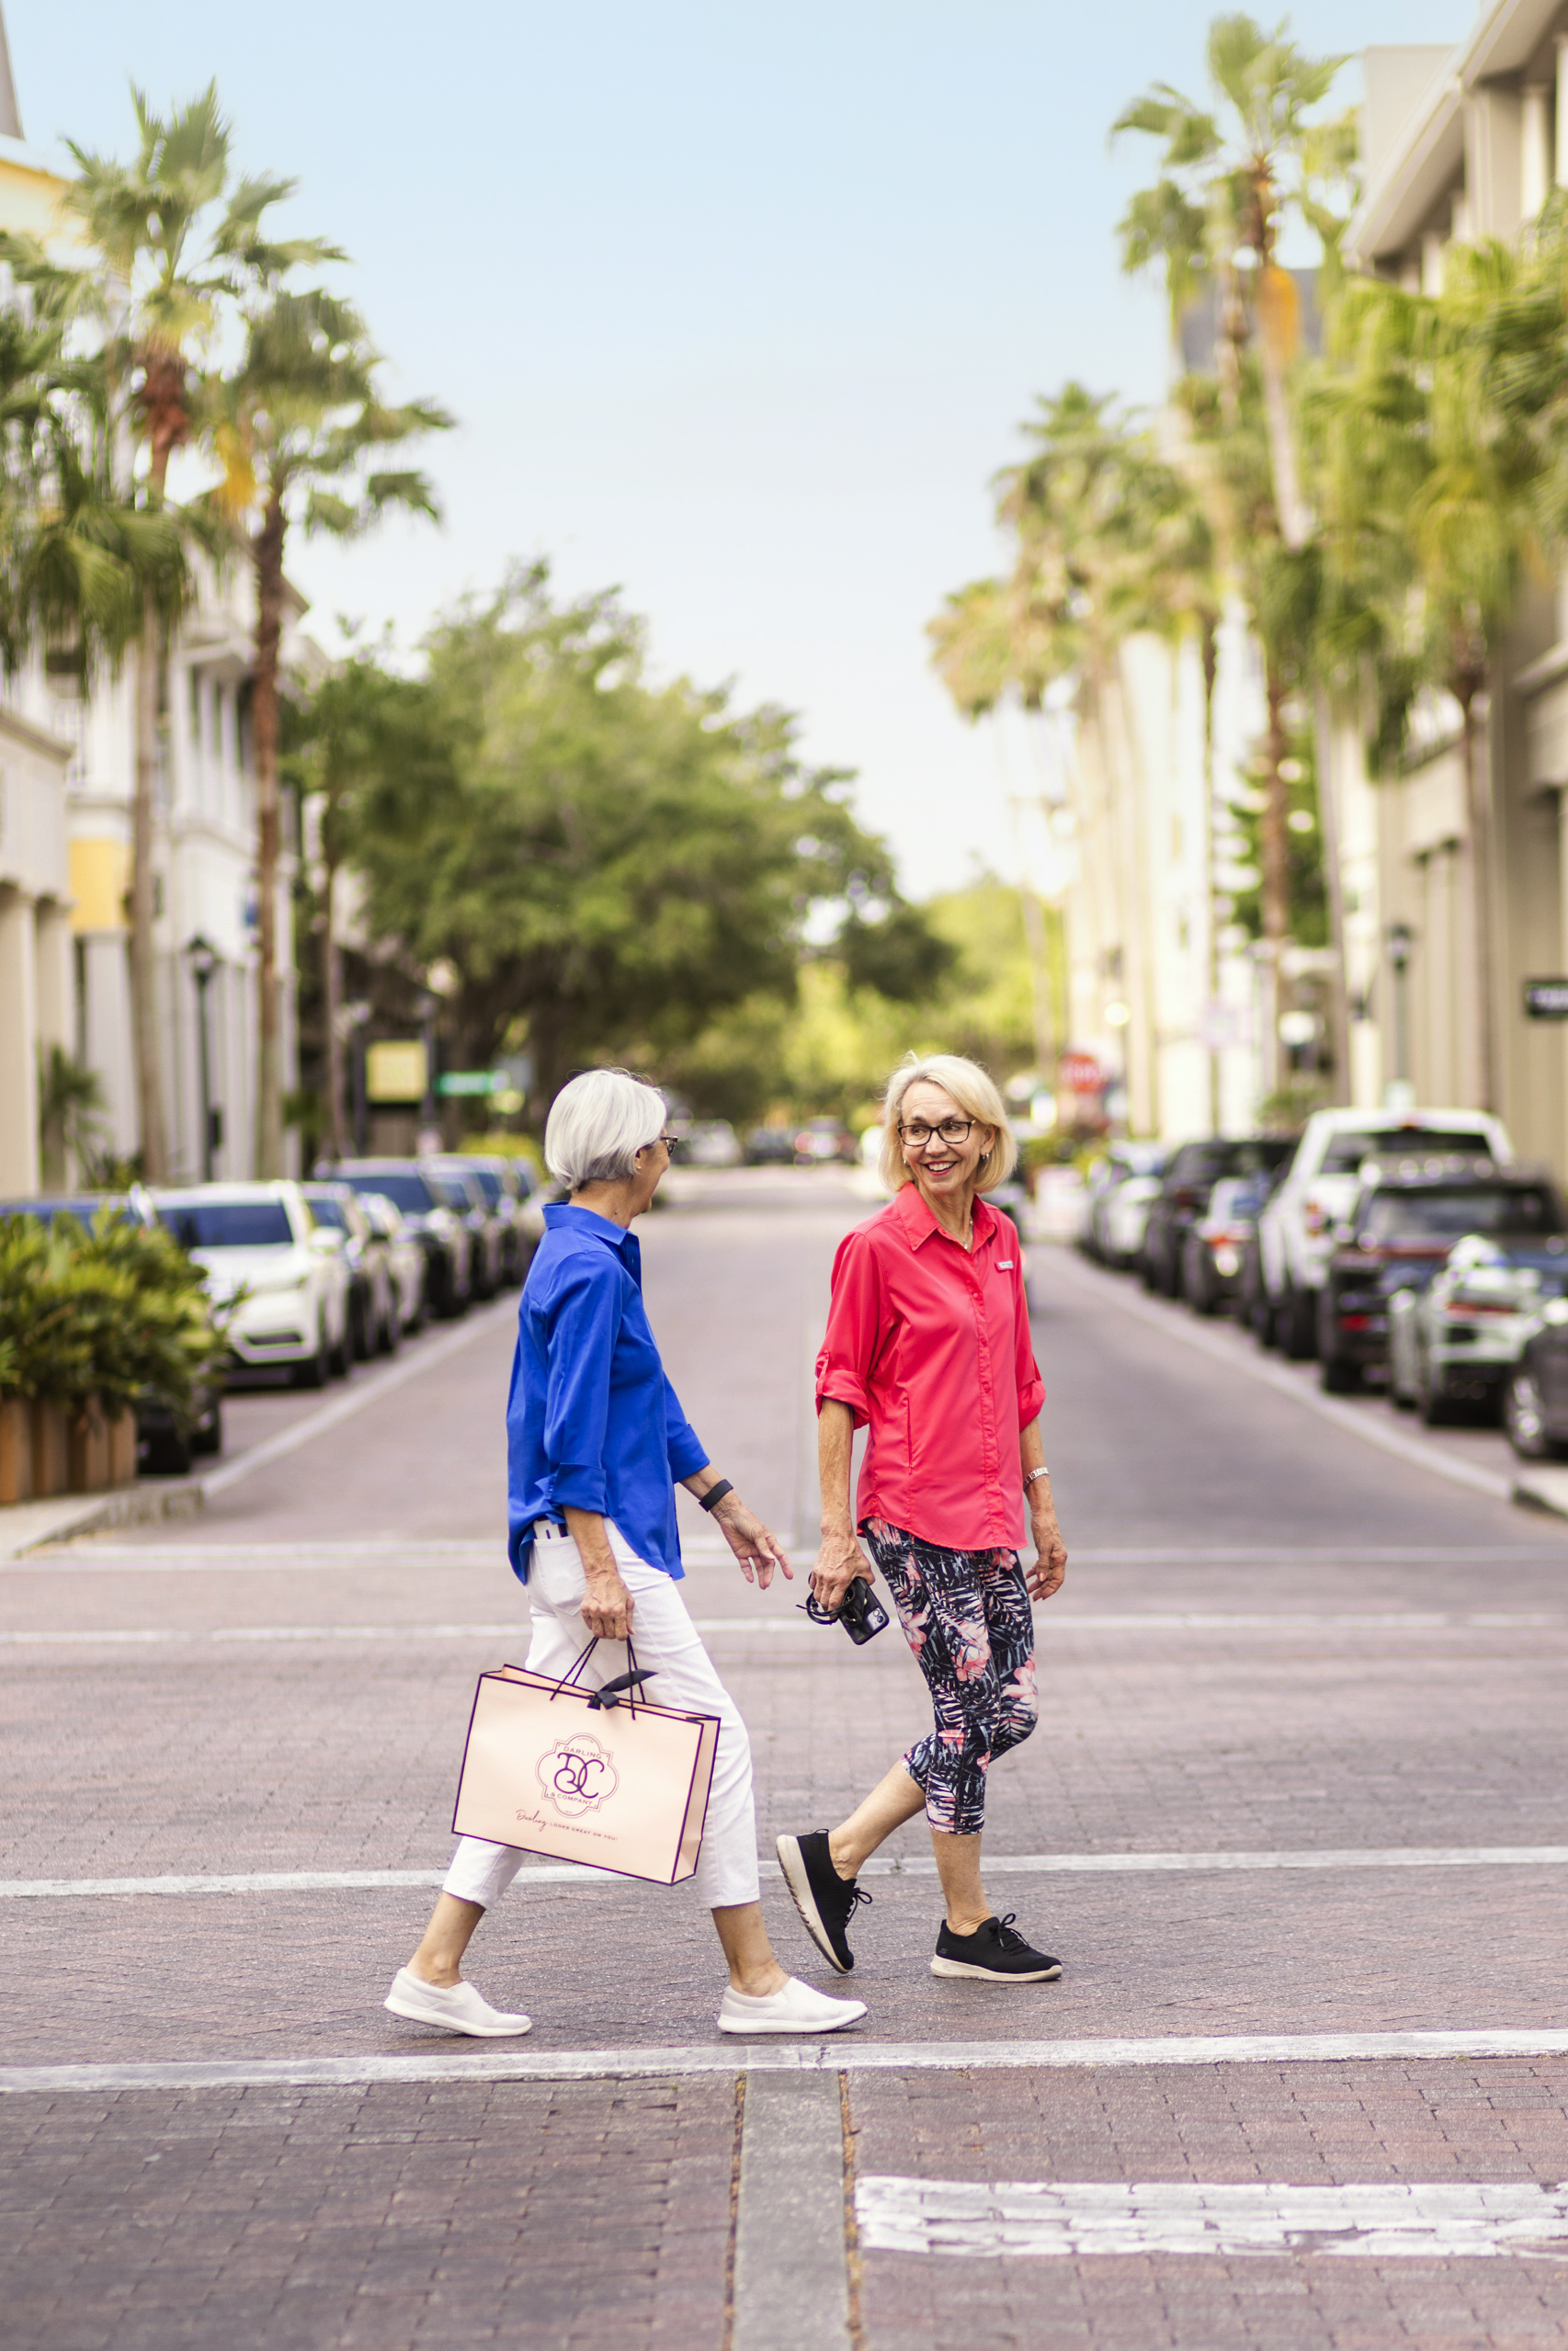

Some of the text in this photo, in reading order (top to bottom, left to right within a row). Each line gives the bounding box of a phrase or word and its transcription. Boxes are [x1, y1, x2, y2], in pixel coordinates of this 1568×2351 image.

[563, 1745, 602, 1759] DARLING
[556, 1793, 593, 1805] COMPANY
[515, 1809, 547, 1832] Darling
[549, 1822, 570, 1830] LOOKS
